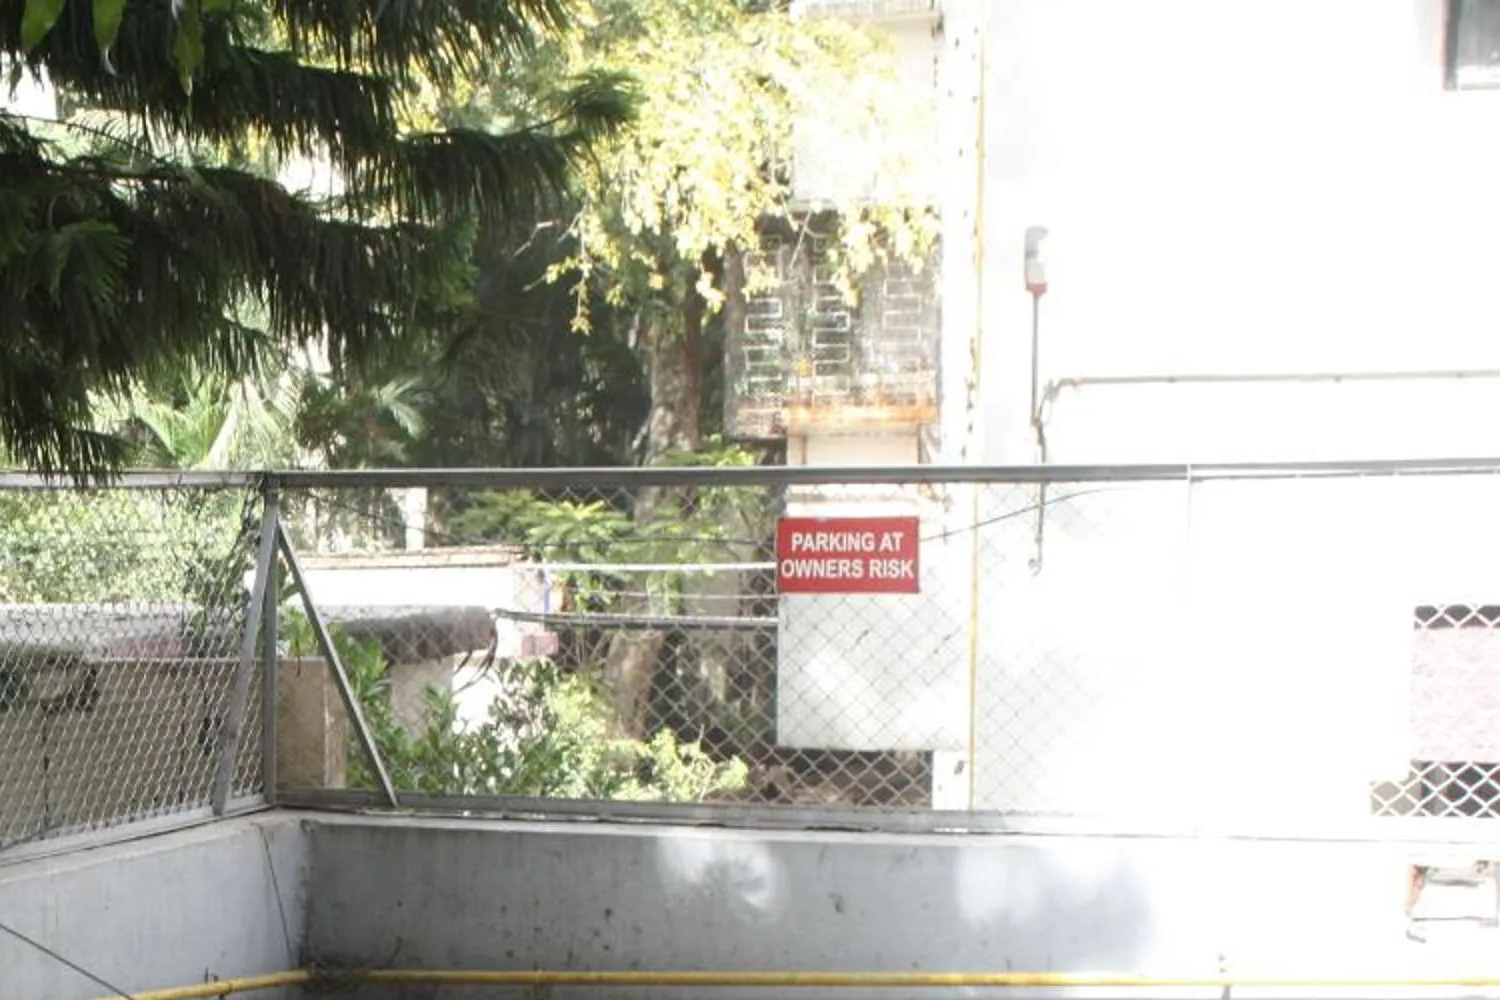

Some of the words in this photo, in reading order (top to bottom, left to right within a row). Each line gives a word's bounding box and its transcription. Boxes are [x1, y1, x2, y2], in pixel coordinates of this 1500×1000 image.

[791, 532, 876, 552] PARKING
[877, 532, 905, 551] AT
[781, 559, 864, 579] OWNERS
[868, 559, 915, 579] RISK
